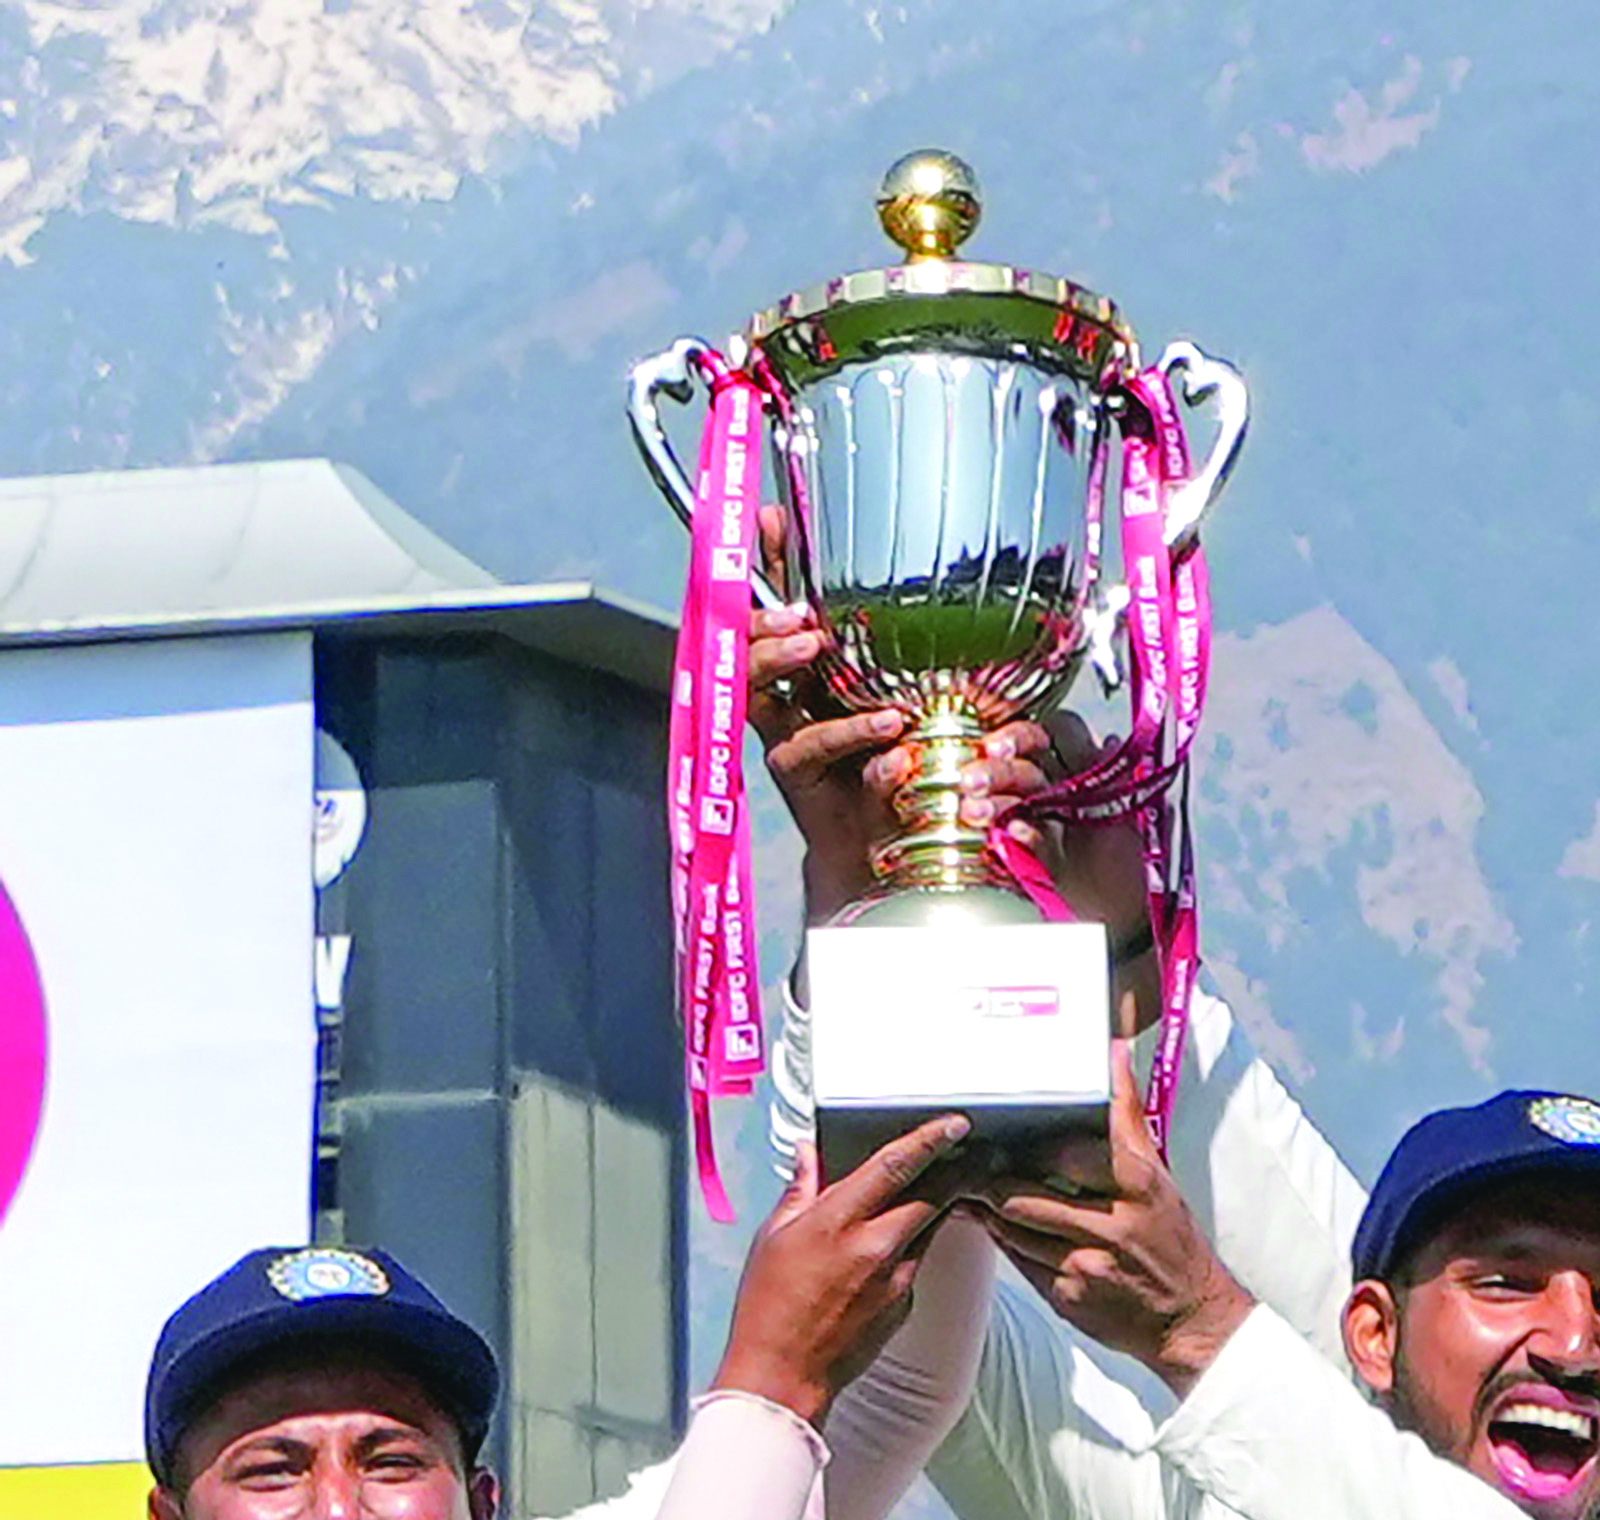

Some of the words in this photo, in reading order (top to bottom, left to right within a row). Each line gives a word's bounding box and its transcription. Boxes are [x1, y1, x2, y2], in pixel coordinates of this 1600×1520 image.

[714, 628, 738, 680] Bank
[711, 682, 735, 743] FIRST
[708, 746, 732, 797] IDFC
[723, 910, 745, 969] FIRST
[727, 970, 749, 1023] IDFC
